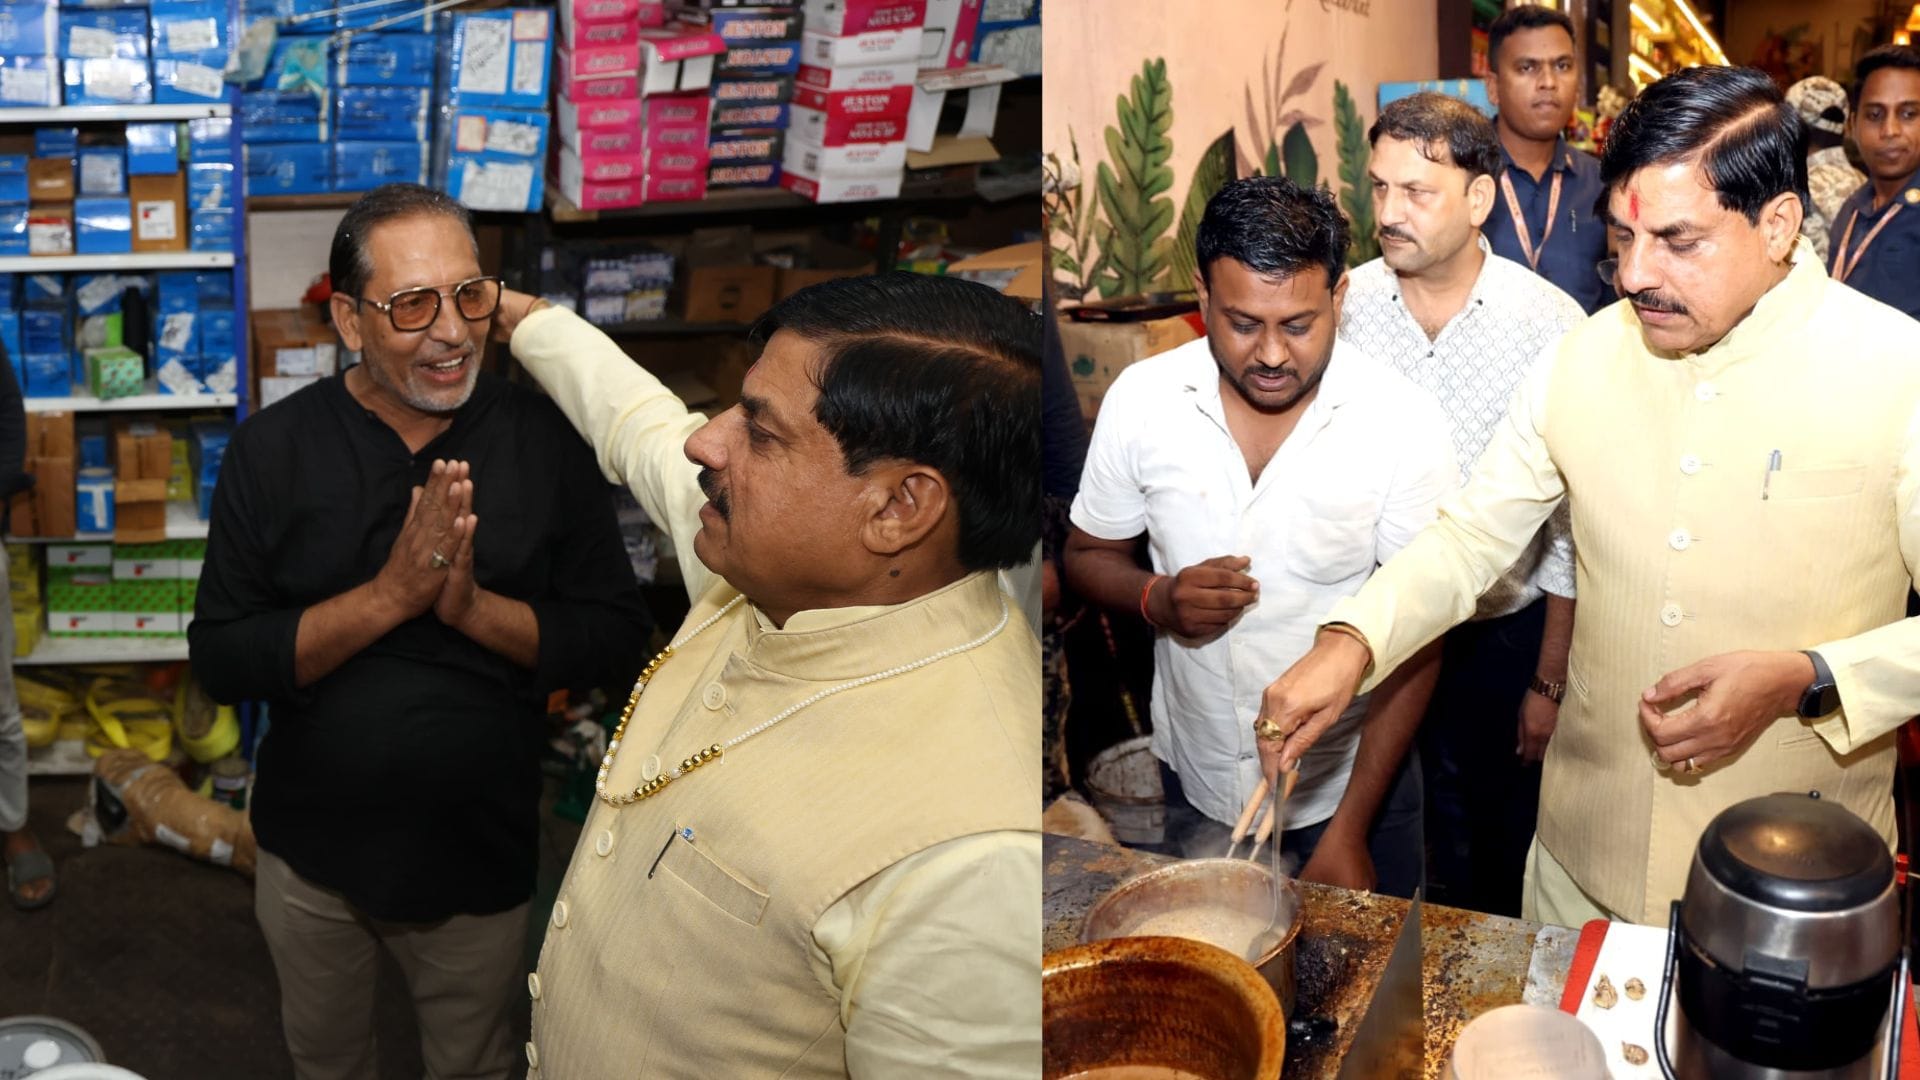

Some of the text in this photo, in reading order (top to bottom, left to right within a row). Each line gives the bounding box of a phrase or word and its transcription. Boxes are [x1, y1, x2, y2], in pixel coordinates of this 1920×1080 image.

[721, 20, 786, 38] JESTON
[727, 48, 792, 66] JESTON
[717, 82, 778, 99] JESTON
[841, 95, 890, 107] JESTON
[720, 106, 781, 123] JESTON
